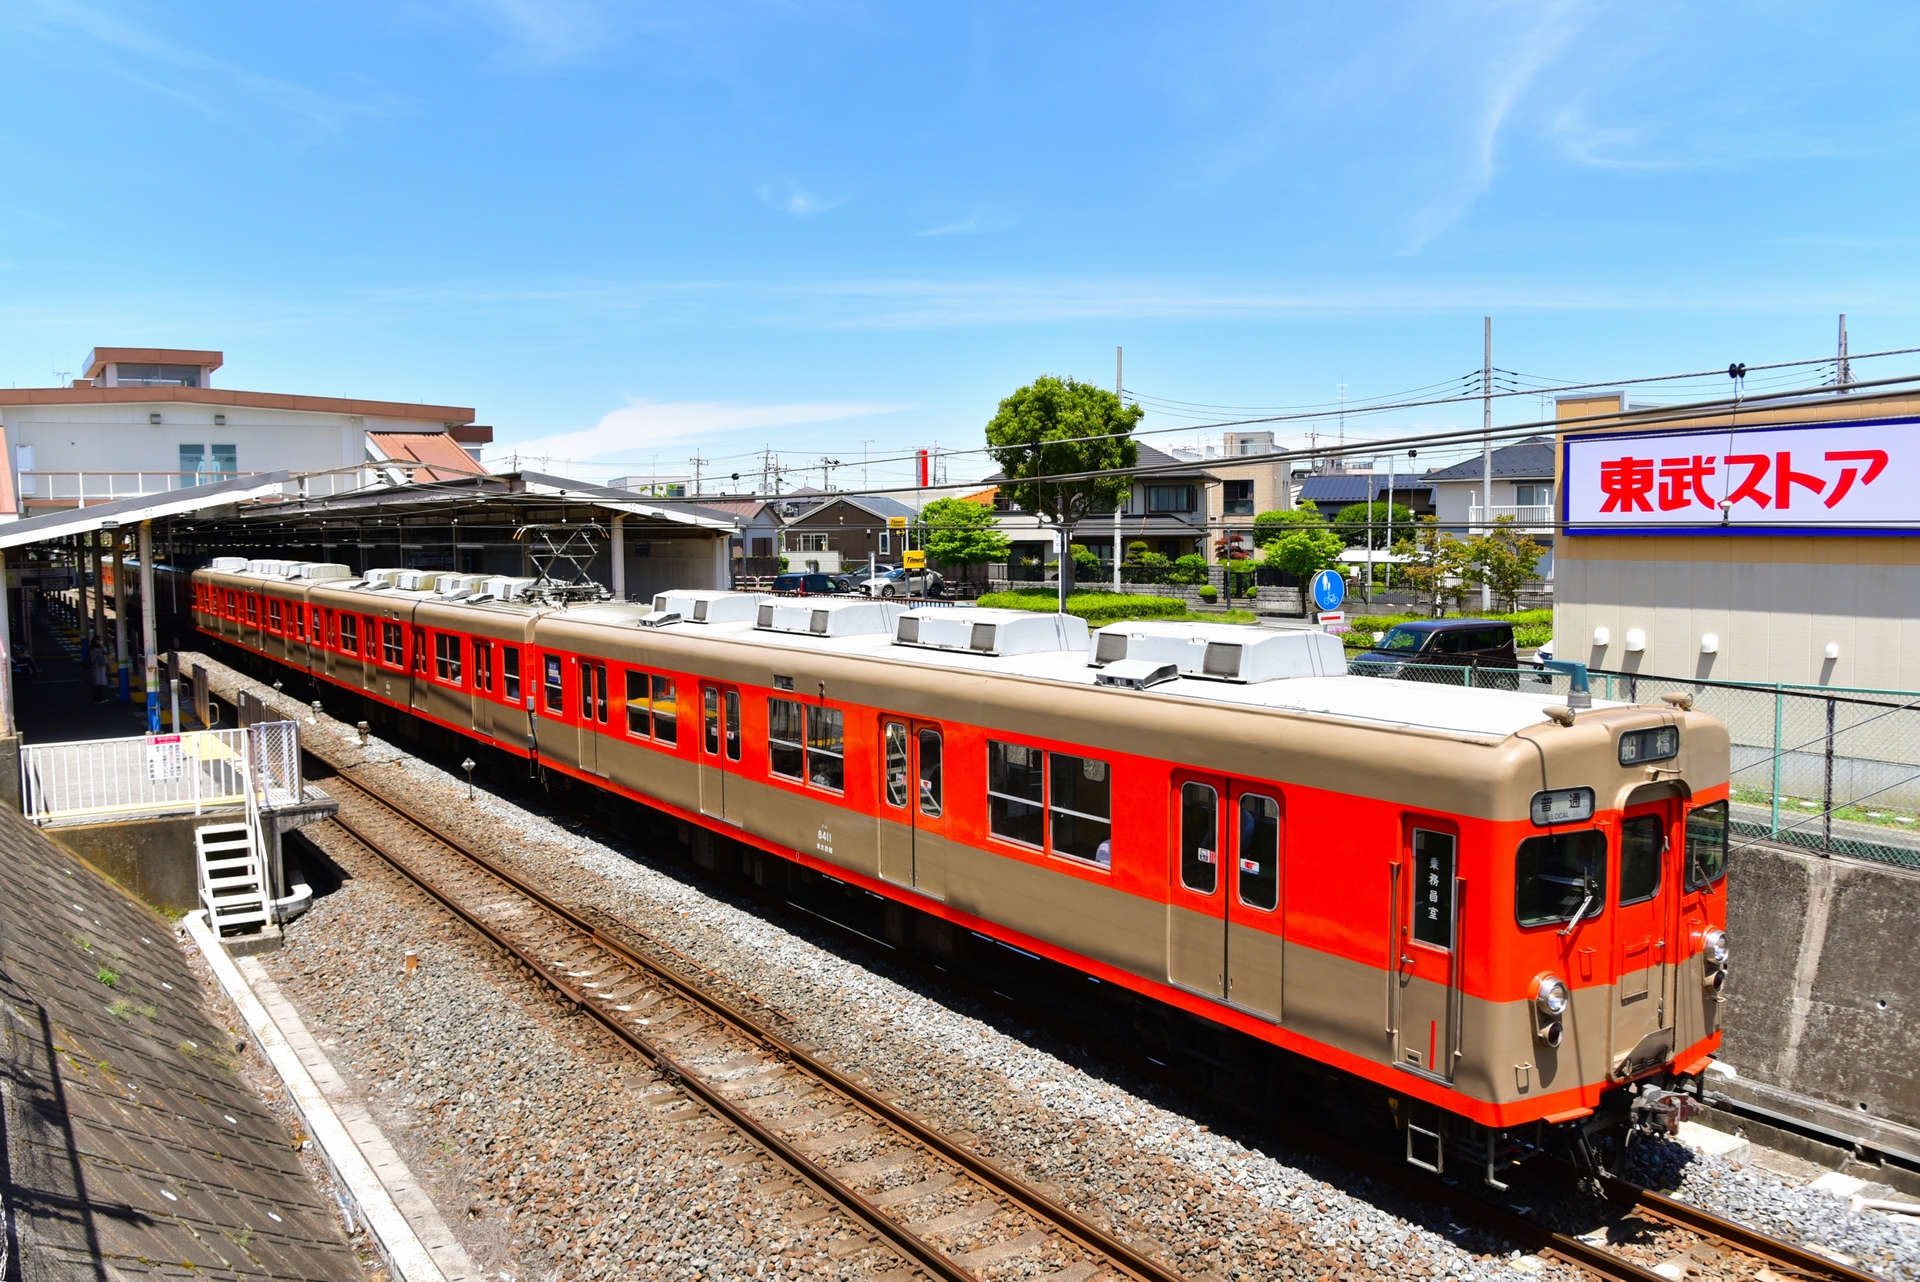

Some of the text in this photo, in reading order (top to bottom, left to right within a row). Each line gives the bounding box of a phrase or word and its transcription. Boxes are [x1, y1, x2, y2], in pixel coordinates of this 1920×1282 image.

[1598, 449, 1889, 513] 東武ストア
[906, 556, 925, 564] Times
[1621, 730, 1671, 760] 船橋
[1540, 793, 1581, 813] 普通
[1551, 812, 1570, 820] LOCAL
[817, 829, 832, 843] 8411
[1428, 857, 1440, 921] 乗務員室
